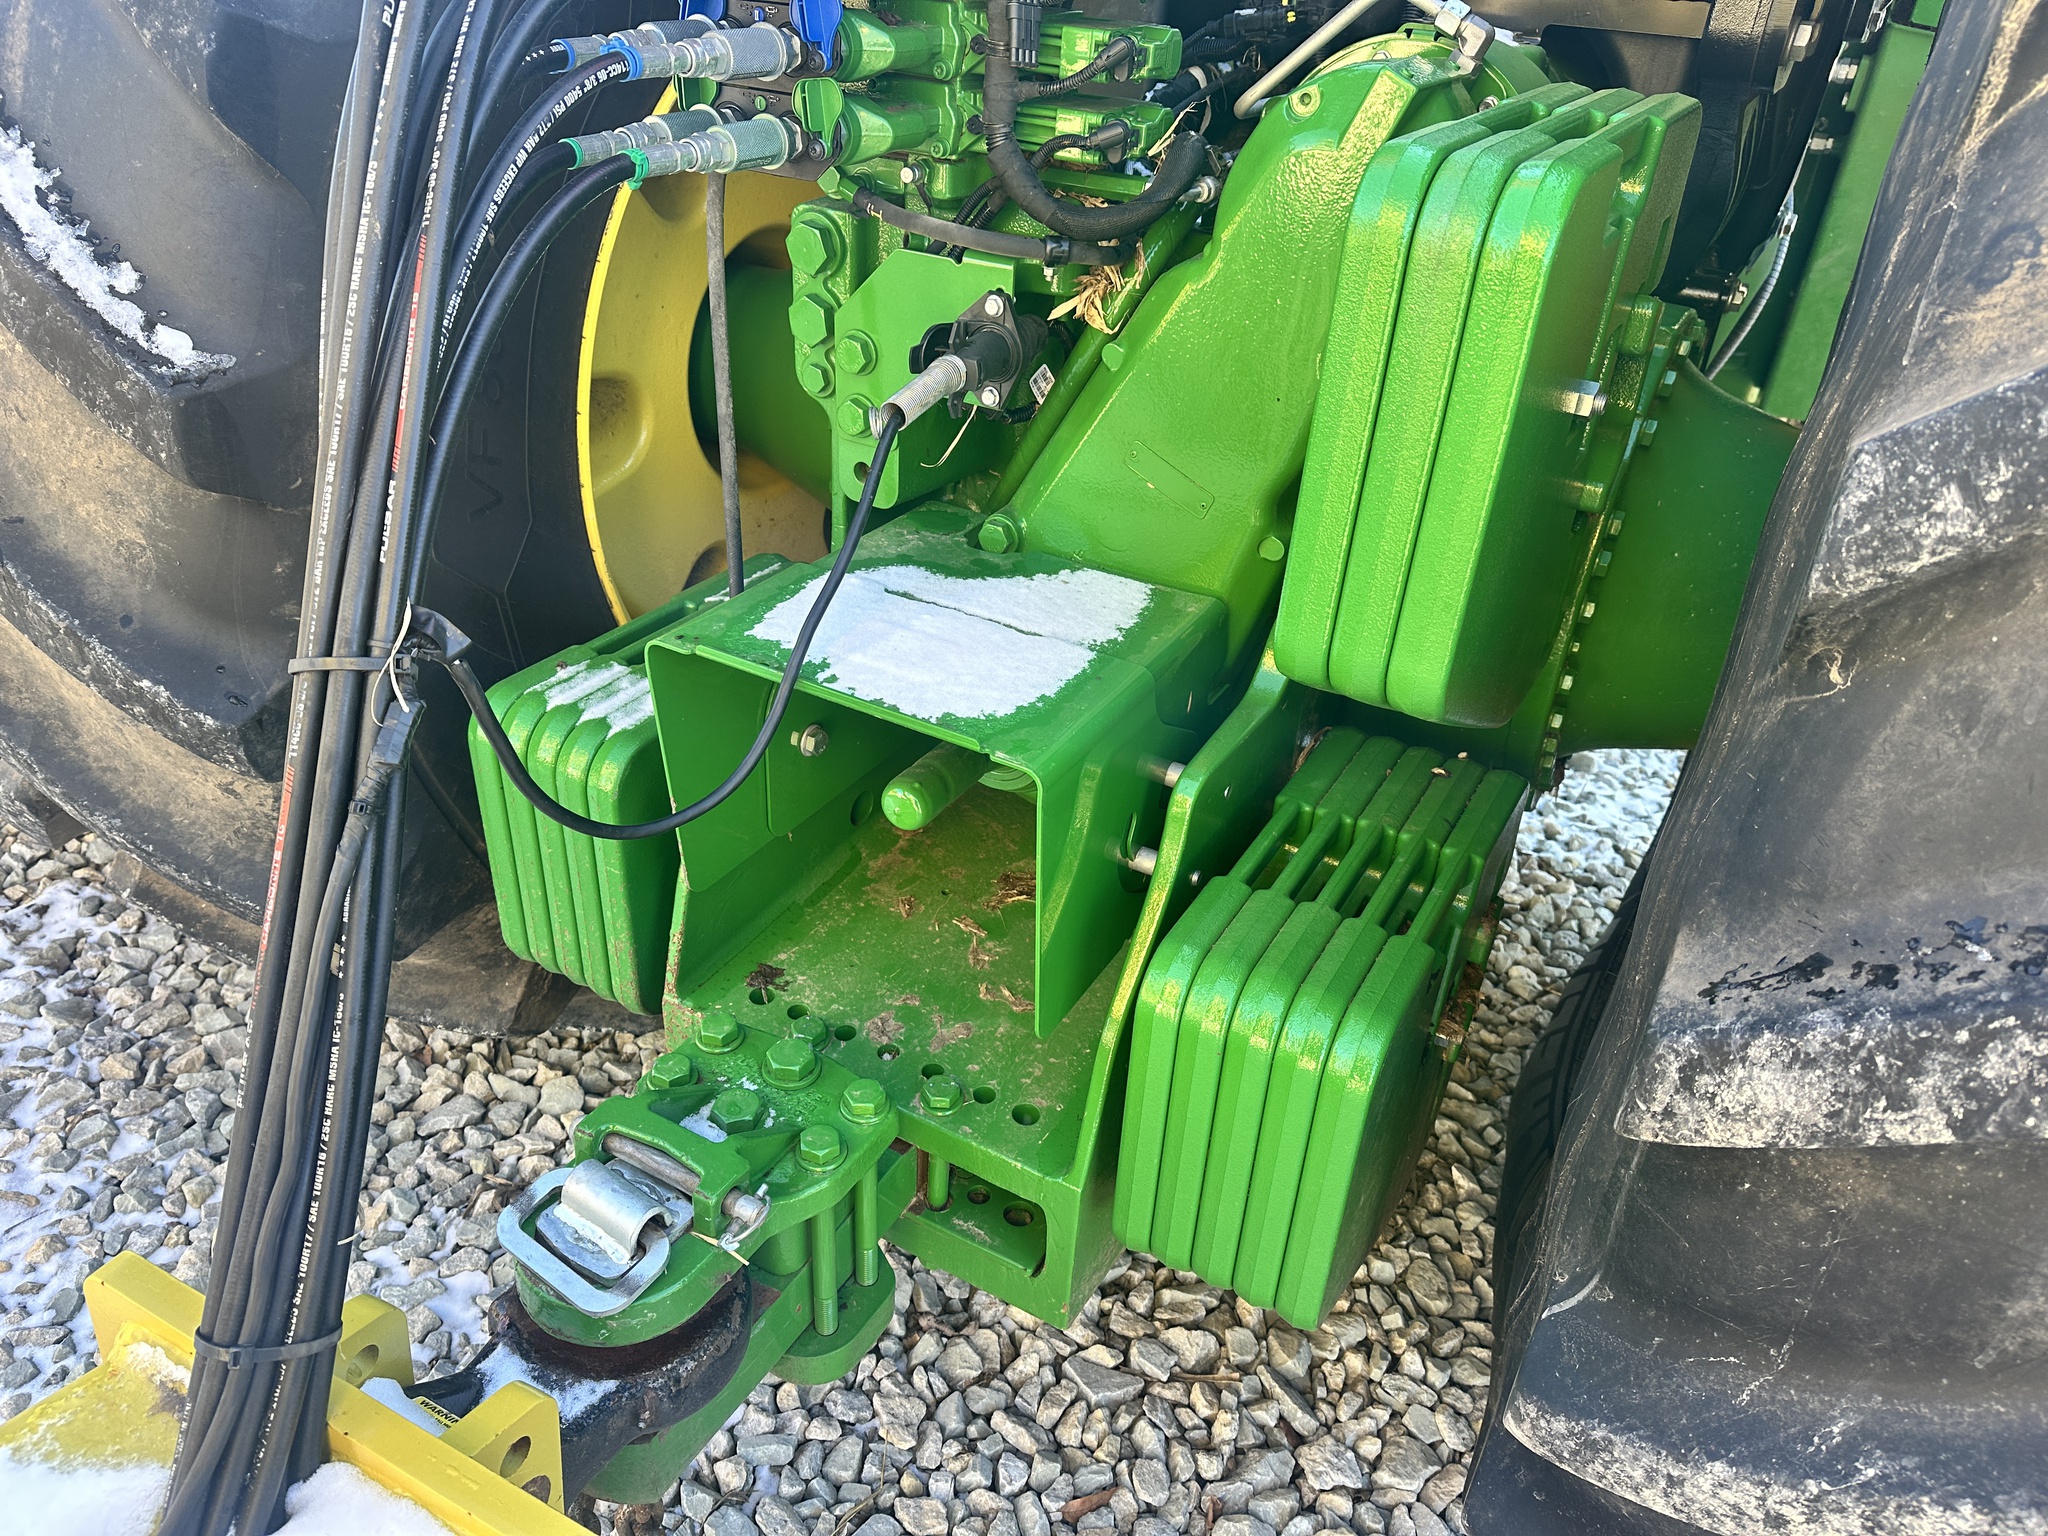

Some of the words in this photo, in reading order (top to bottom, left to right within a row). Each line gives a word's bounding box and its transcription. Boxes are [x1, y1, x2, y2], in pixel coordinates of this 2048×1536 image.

[552, 100, 566, 118] PSI
[564, 86, 583, 108] 5400
[514, 148, 528, 168] WP
[493, 163, 518, 204] EXCEEDS
[356, 217, 370, 254] MSHA
[350, 257, 364, 290] HARC
[347, 292, 358, 317] 2SC
[337, 378, 347, 401] SAE
[326, 460, 336, 482] SAE
[380, 480, 396, 564] PULSAR
[328, 1043, 340, 1079] MSHA
[324, 1082, 336, 1114] HARC
[321, 1118, 332, 1141] 2SC
[313, 1153, 327, 1196] 100R16
[308, 1200, 320, 1222] SAE
